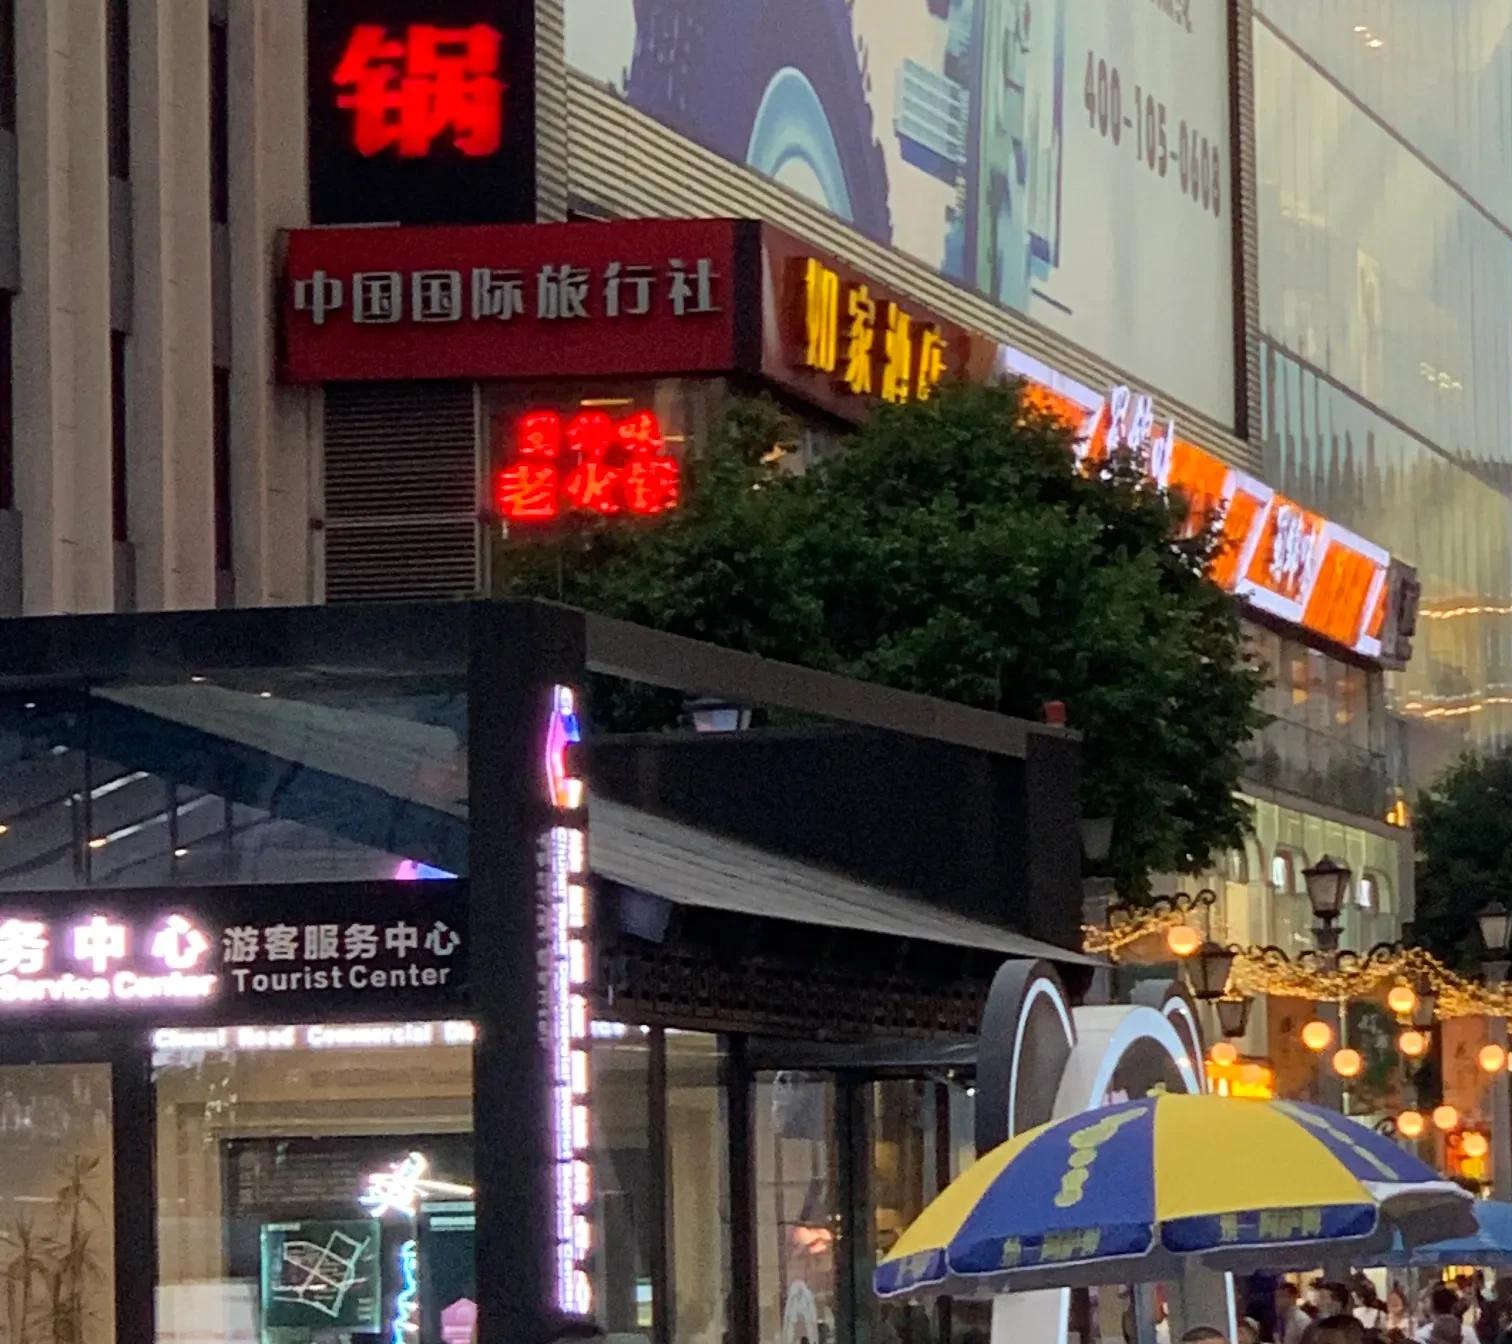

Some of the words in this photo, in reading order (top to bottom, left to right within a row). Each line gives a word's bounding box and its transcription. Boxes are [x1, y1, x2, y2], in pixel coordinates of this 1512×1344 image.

[294, 257, 725, 325] 中国国际旅行社
[223, 920, 462, 963] 游客服务中心
[112, 971, 217, 999] Center
[232, 968, 342, 993] Tourist
[349, 964, 451, 989] Center
